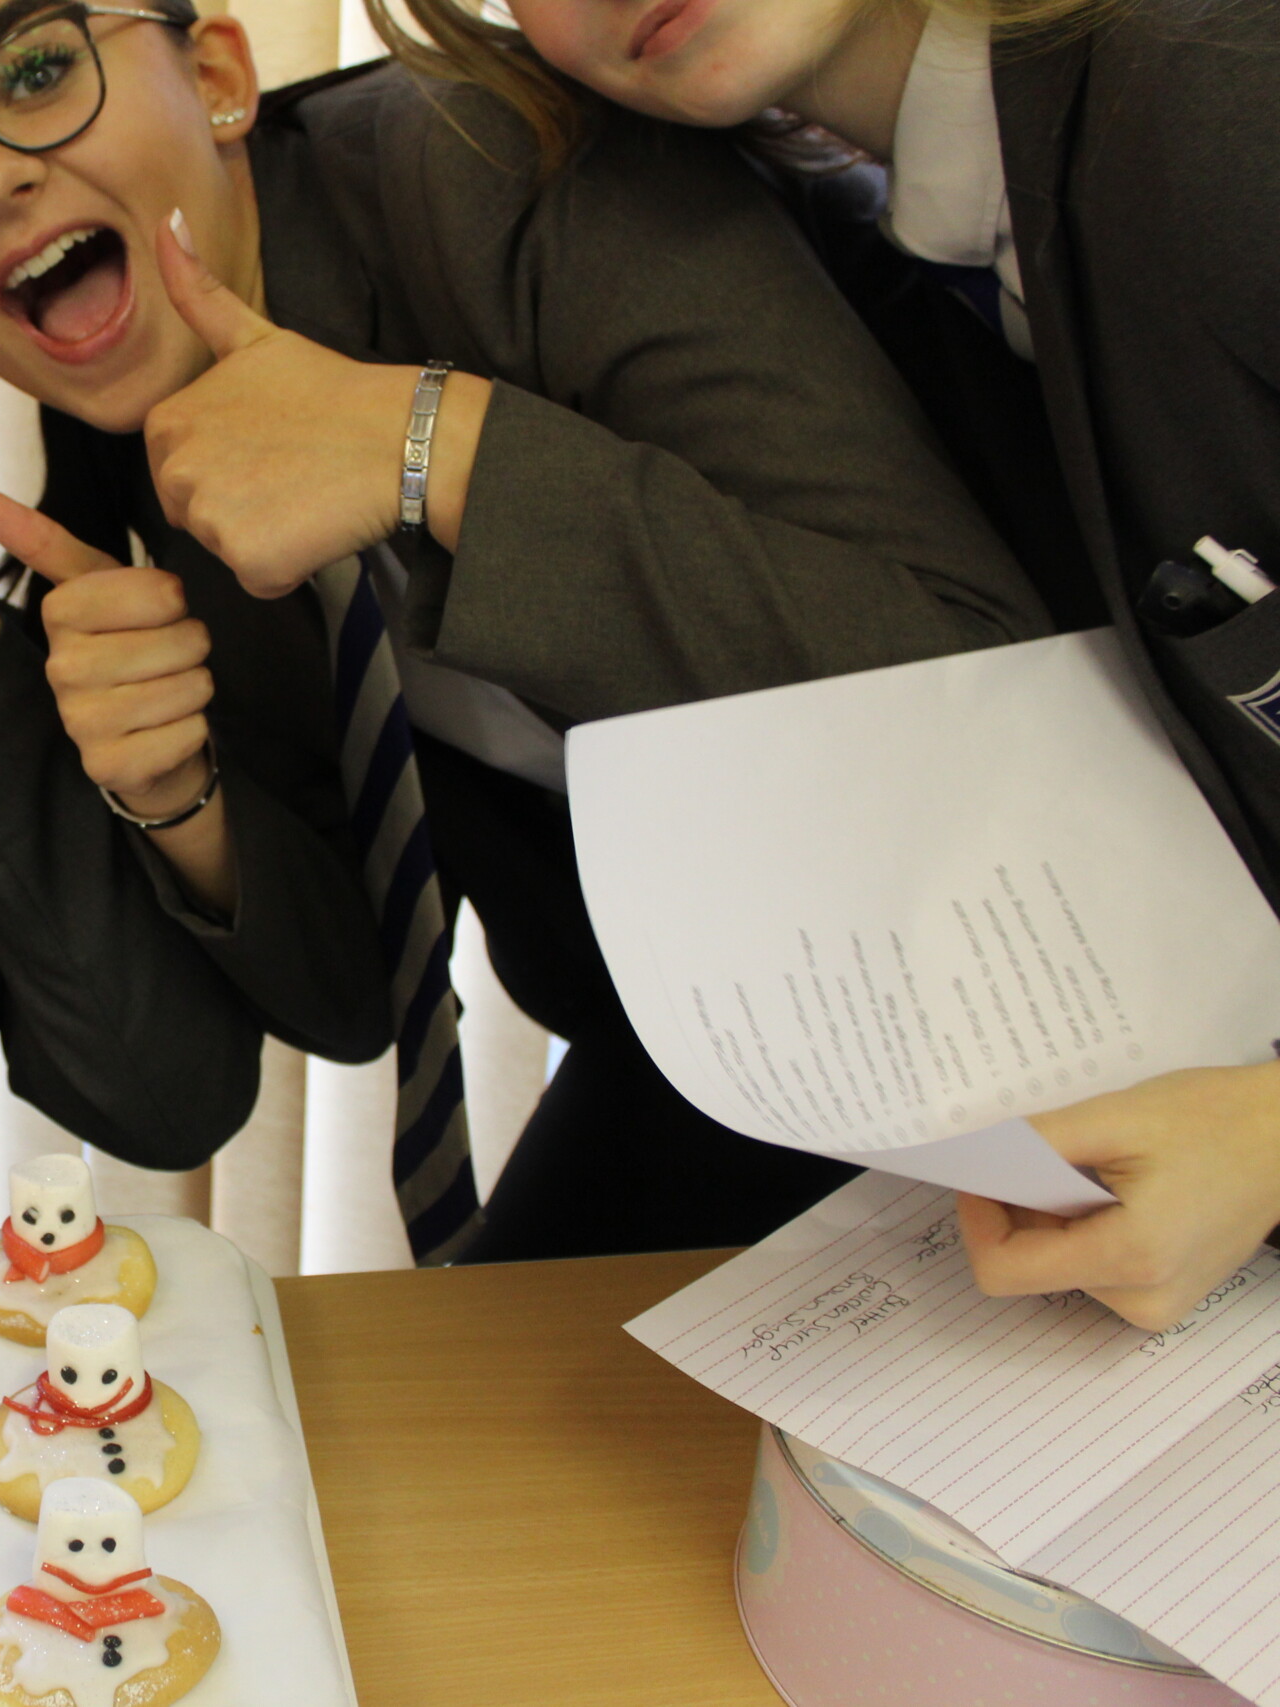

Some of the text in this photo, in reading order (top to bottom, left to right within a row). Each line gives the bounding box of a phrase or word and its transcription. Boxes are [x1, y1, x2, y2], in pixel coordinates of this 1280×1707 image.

[849, 1294, 910, 1334] Butter
[742, 1313, 805, 1359] Sugar
[769, 1320, 831, 1361] Syrup
